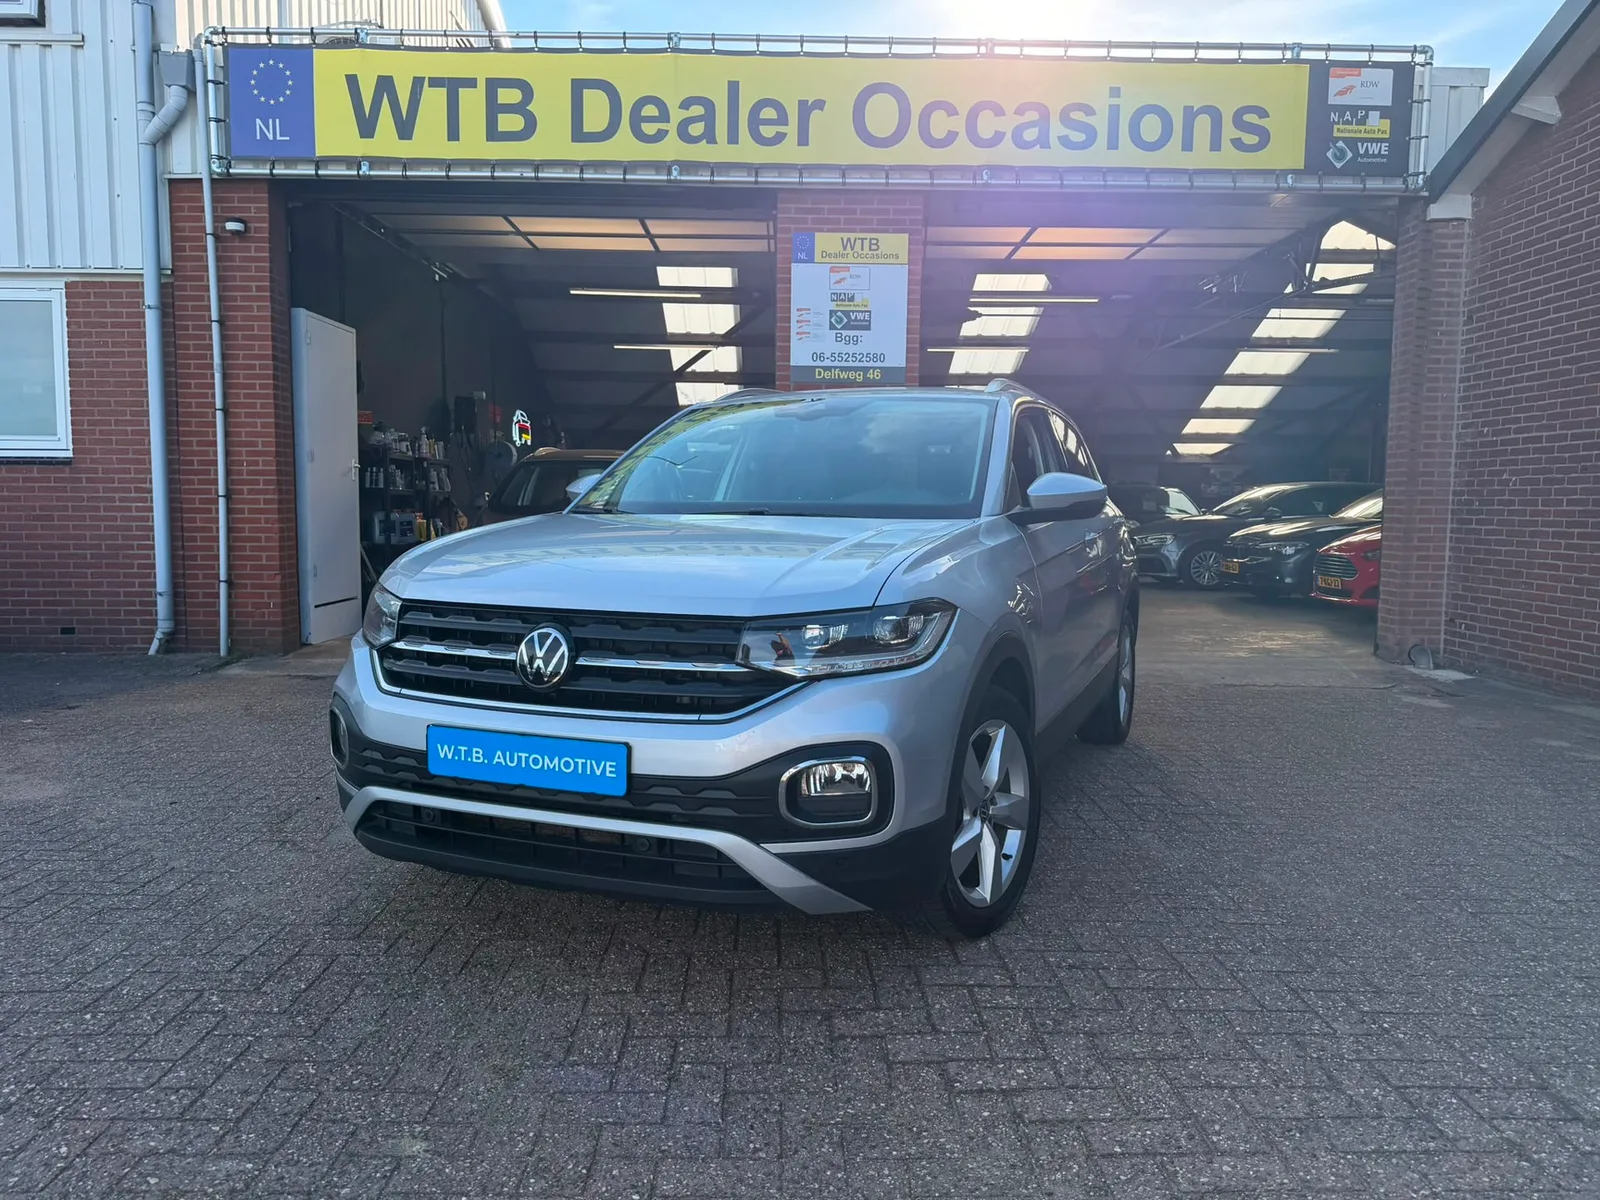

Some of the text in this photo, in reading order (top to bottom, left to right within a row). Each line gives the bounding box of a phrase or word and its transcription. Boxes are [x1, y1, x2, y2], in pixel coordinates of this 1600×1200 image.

[1360, 80, 1380, 89] RDW
[344, 73, 1272, 153] WTB Dealer Occasions
[255, 118, 290, 141] NL
[1357, 142, 1389, 155] VWE
[840, 237, 880, 251] WTB
[797, 252, 808, 260] NL
[821, 250, 900, 260] Dealer Occasions
[850, 312, 870, 320] VWE
[835, 332, 863, 345] Bgg:
[811, 351, 886, 363] 06-55252580
[815, 368, 881, 382] Delfweg 46
[437, 743, 617, 778] W.T.B. AUTOMOTIVE
